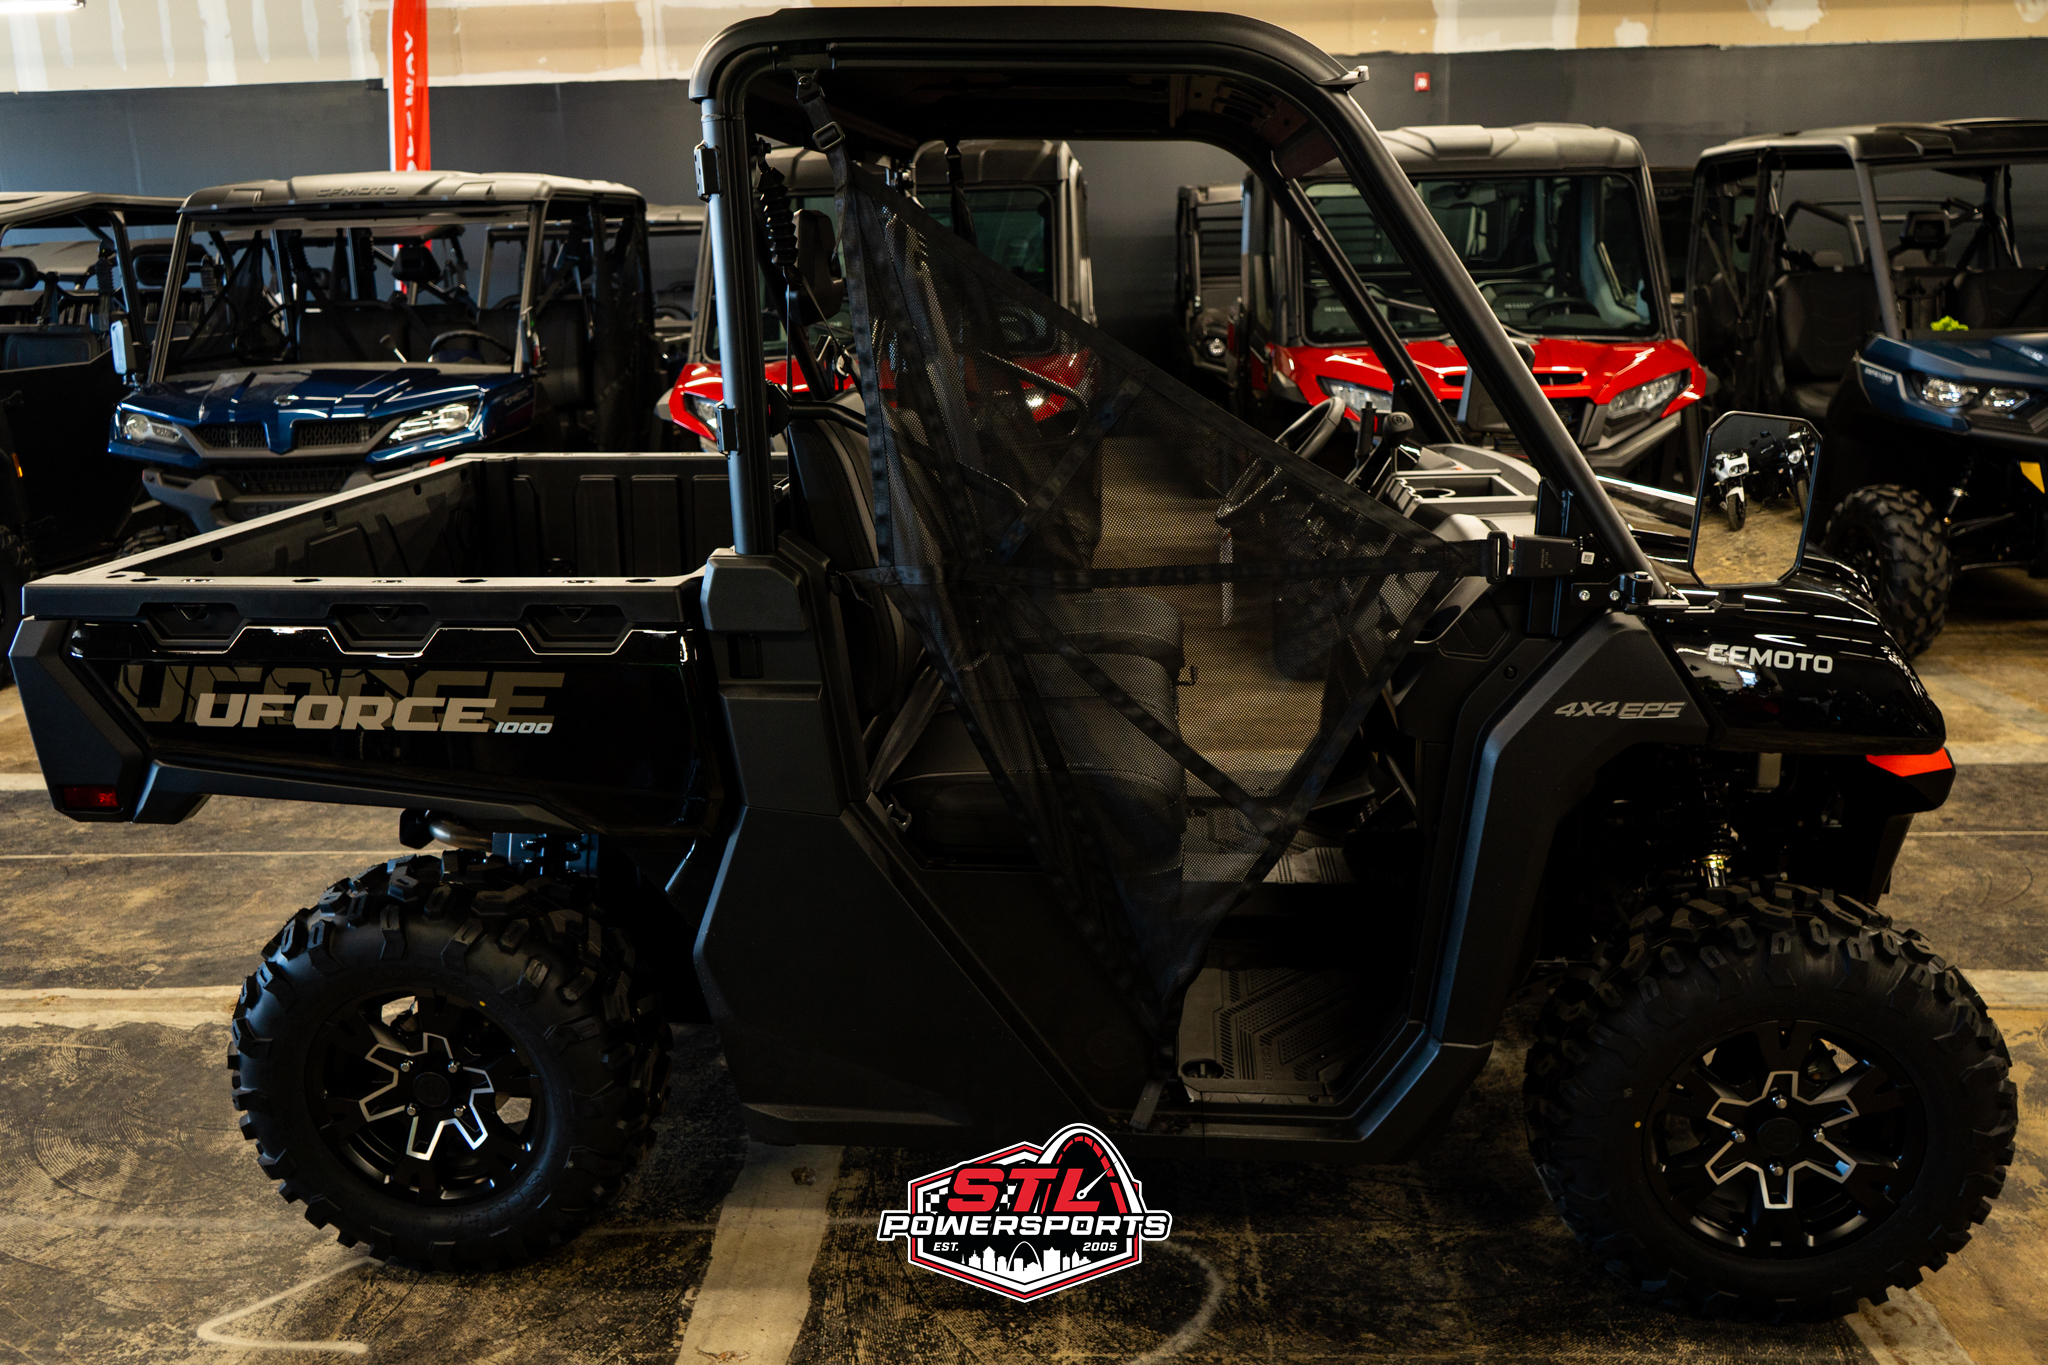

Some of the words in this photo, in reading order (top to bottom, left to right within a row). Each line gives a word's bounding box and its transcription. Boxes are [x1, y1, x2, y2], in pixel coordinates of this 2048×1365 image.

[316, 185, 399, 198] CFMOTO
[1708, 643, 1834, 674] CFMOTO
[194, 692, 497, 733] UFORCE
[494, 721, 554, 735] 1000
[1554, 701, 1619, 718] 4X4
[1619, 701, 1688, 719] EPS
